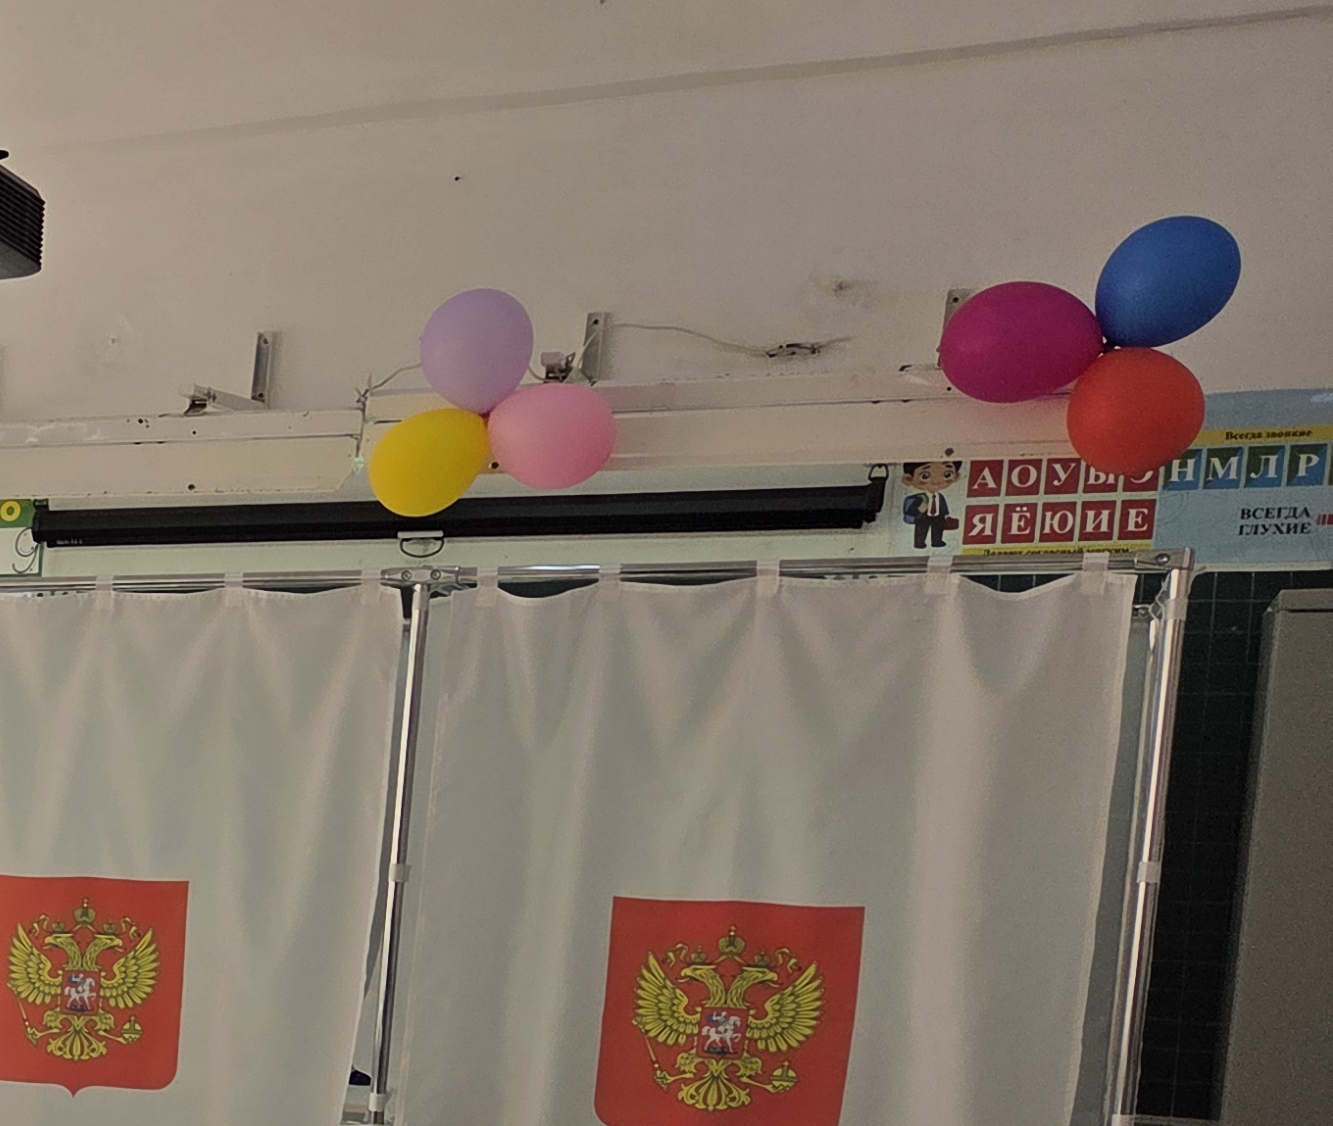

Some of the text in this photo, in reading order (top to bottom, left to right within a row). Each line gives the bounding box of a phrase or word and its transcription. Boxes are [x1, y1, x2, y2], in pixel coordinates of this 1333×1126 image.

[1225, 431, 1263, 441] Всегда
[972, 466, 997, 489] А
[1011, 464, 1037, 488] О
[1051, 463, 1077, 486] У
[1170, 458, 1196, 482] Н
[1206, 456, 1239, 480] М
[1250, 455, 1279, 479] Л
[1297, 453, 1320, 477] Р
[968, 507, 1149, 536] Я Ё Ю И Е
[1240, 507, 1311, 520] ВСЕГДА
[1238, 523, 1312, 536] ГЛУХИЕ
[12, 527, 39, 574] 9
